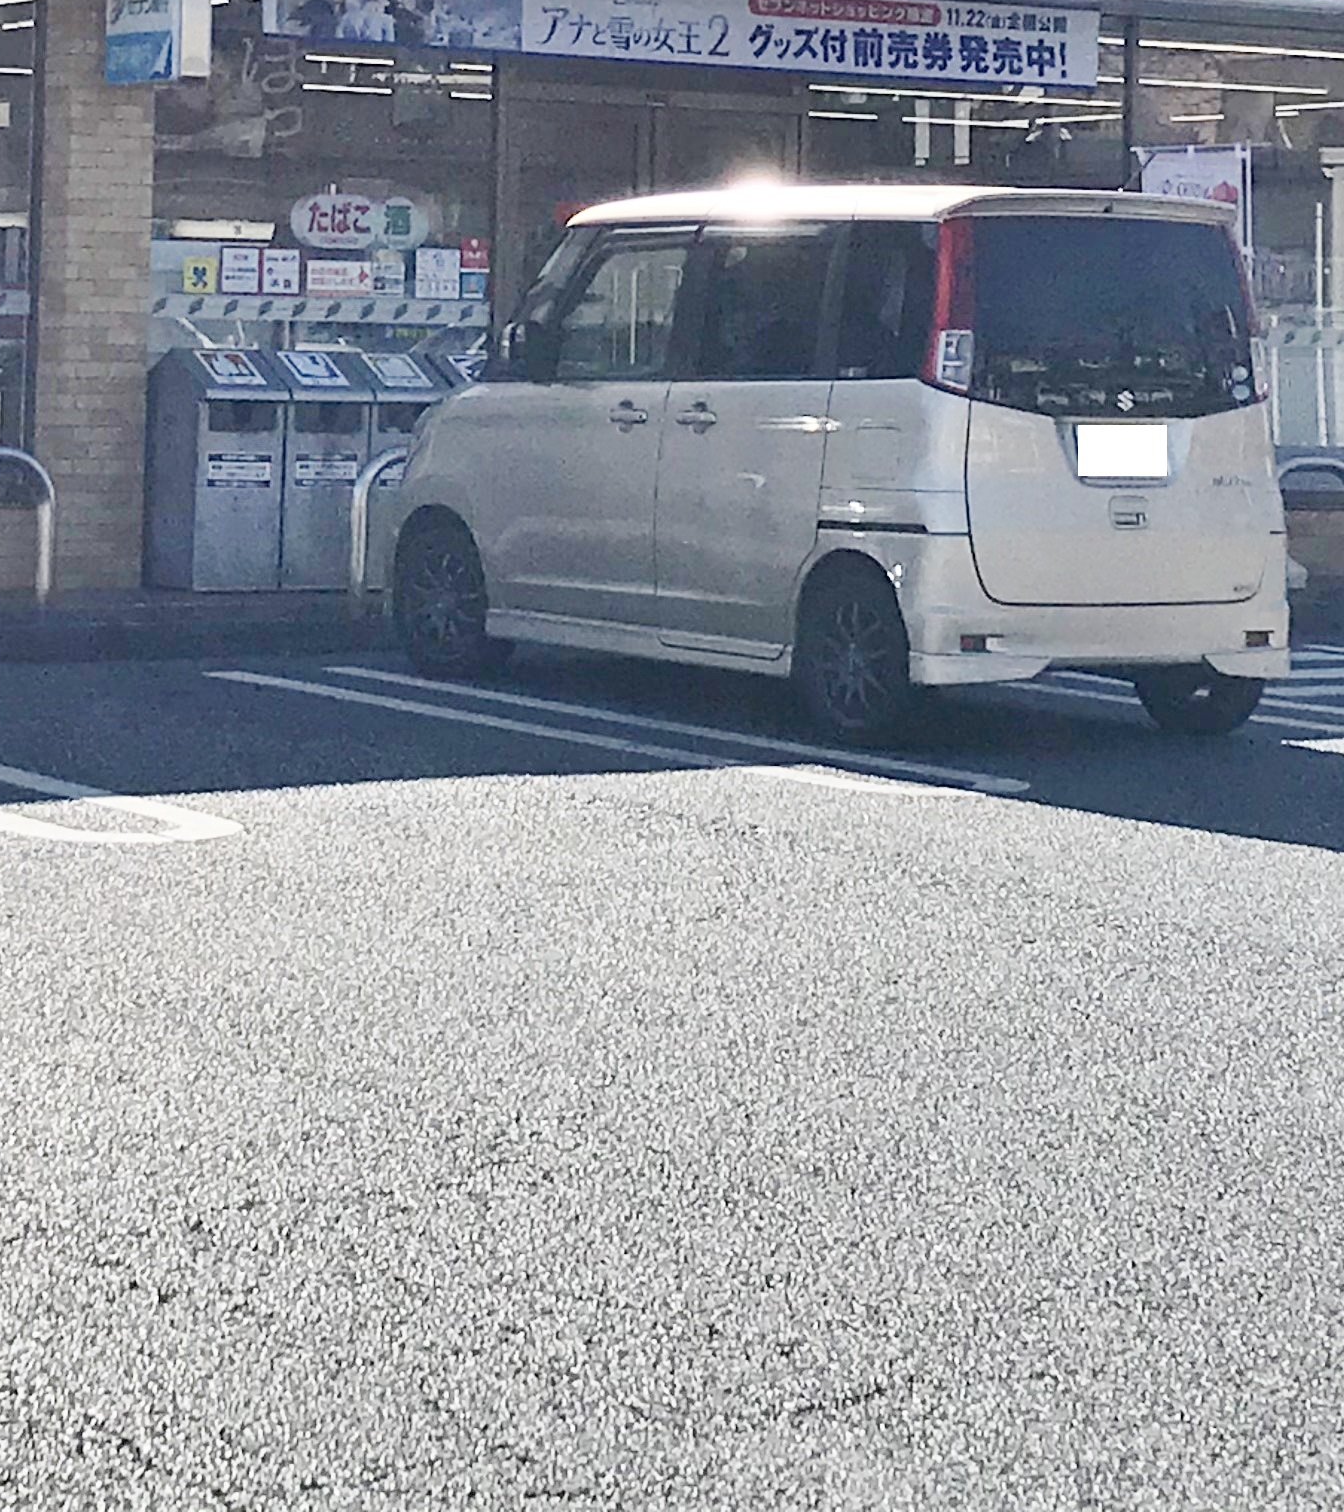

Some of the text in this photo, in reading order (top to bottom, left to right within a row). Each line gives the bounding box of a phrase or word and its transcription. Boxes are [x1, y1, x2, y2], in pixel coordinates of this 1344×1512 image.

[307, 201, 371, 235] たばこ
[383, 203, 412, 236] 酒
